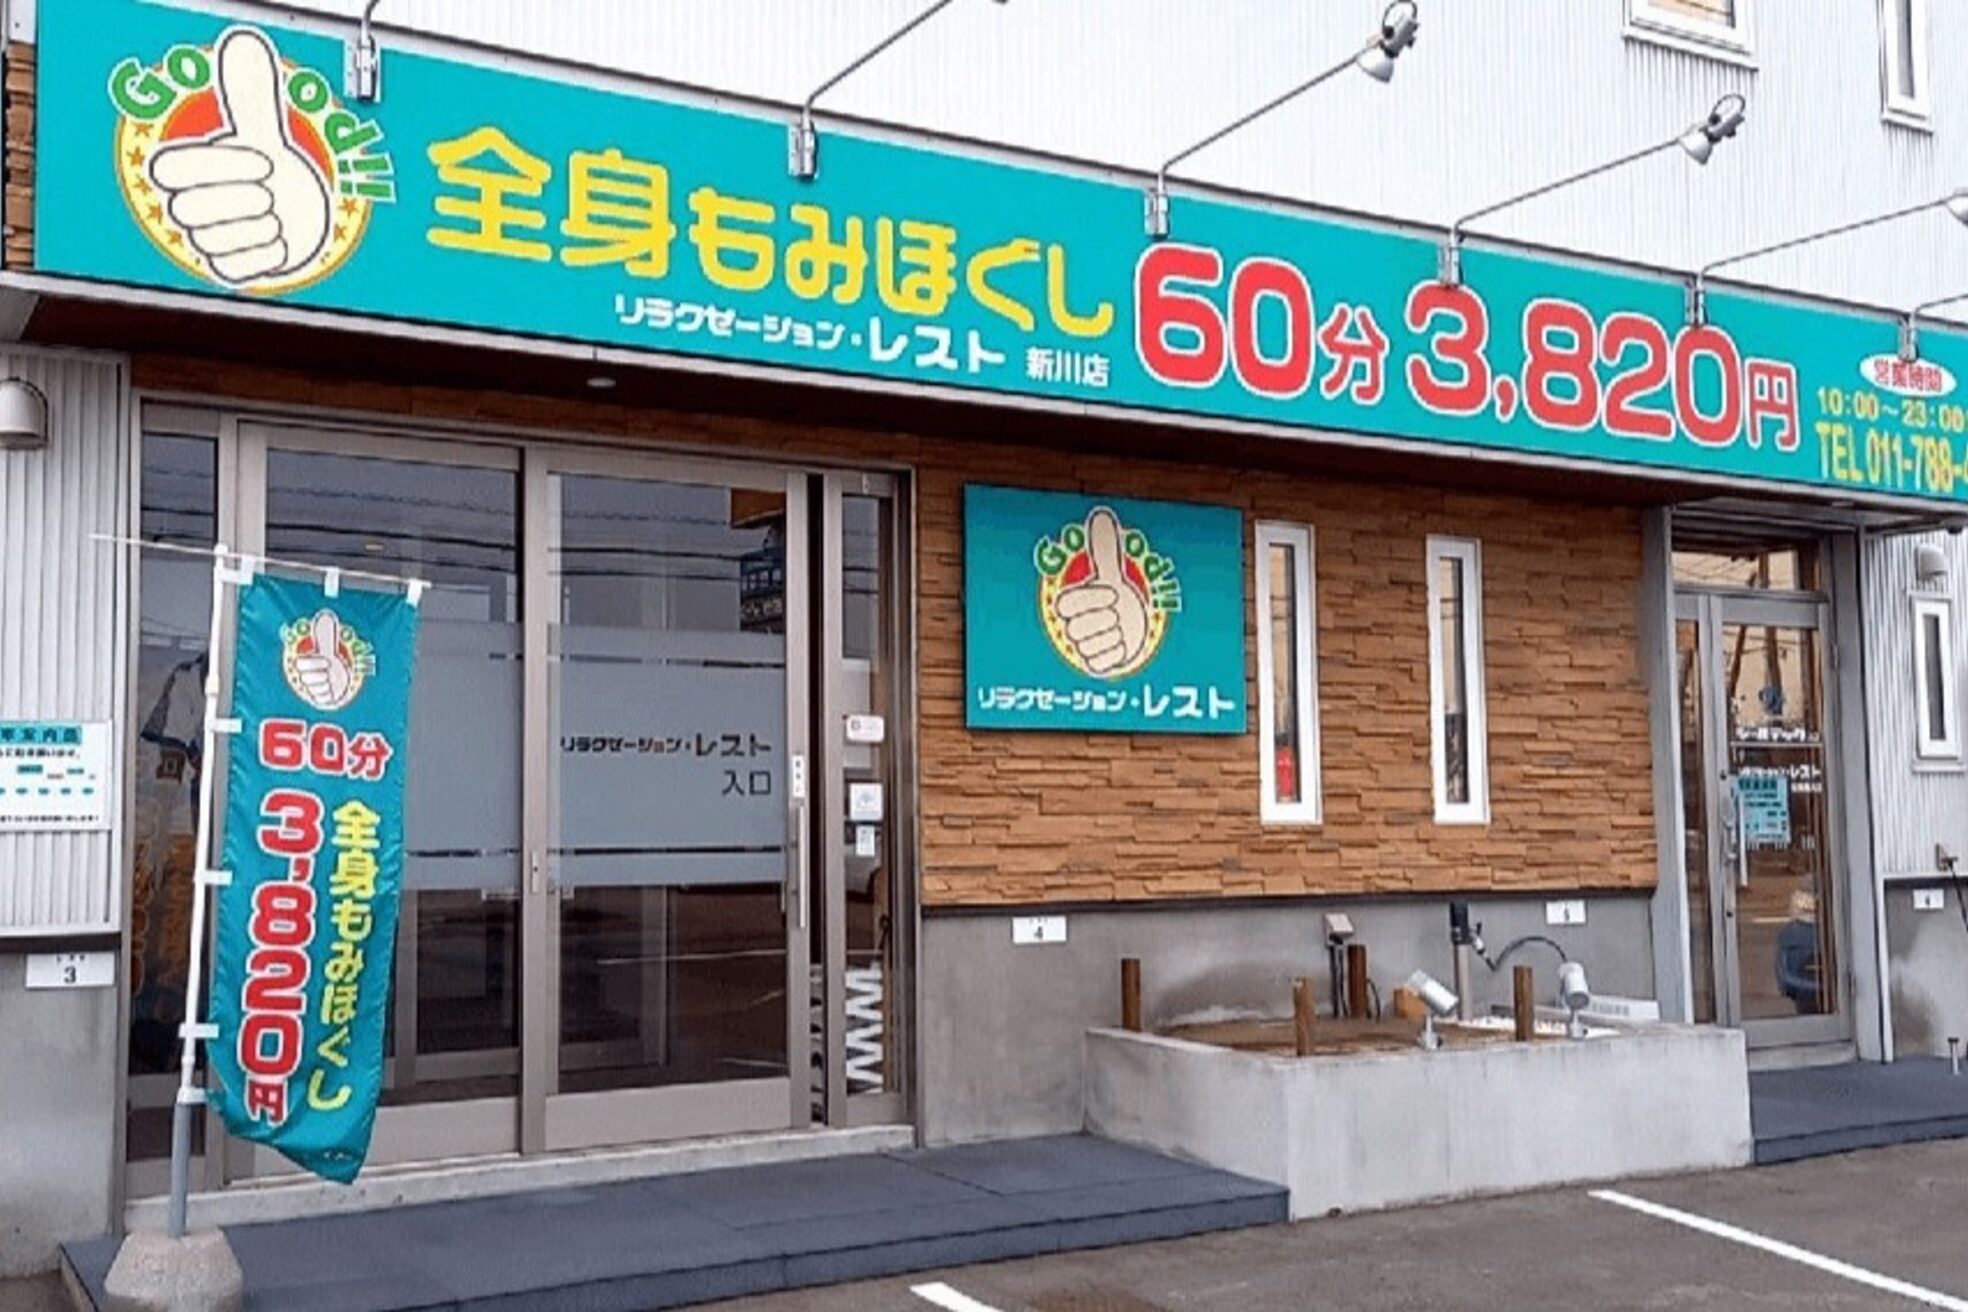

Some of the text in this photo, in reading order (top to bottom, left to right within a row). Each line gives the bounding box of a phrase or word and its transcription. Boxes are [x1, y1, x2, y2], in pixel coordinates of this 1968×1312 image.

[426, 126, 1114, 338] 全身もみほぐし
[614, 293, 1111, 388] リラクゼーション・レスト 新川店
[1135, 243, 1799, 453] 60分 3,820円
[1814, 421, 1968, 494] TEL 011-788-
[977, 684, 1236, 719] リラクゼーション・レスト
[258, 718, 393, 781] 60分
[559, 732, 772, 758] リラクゼーション・レスト
[721, 769, 772, 796] 入口
[63, 965, 77, 984] 3
[307, 798, 382, 1112] 全身もみほぐし
